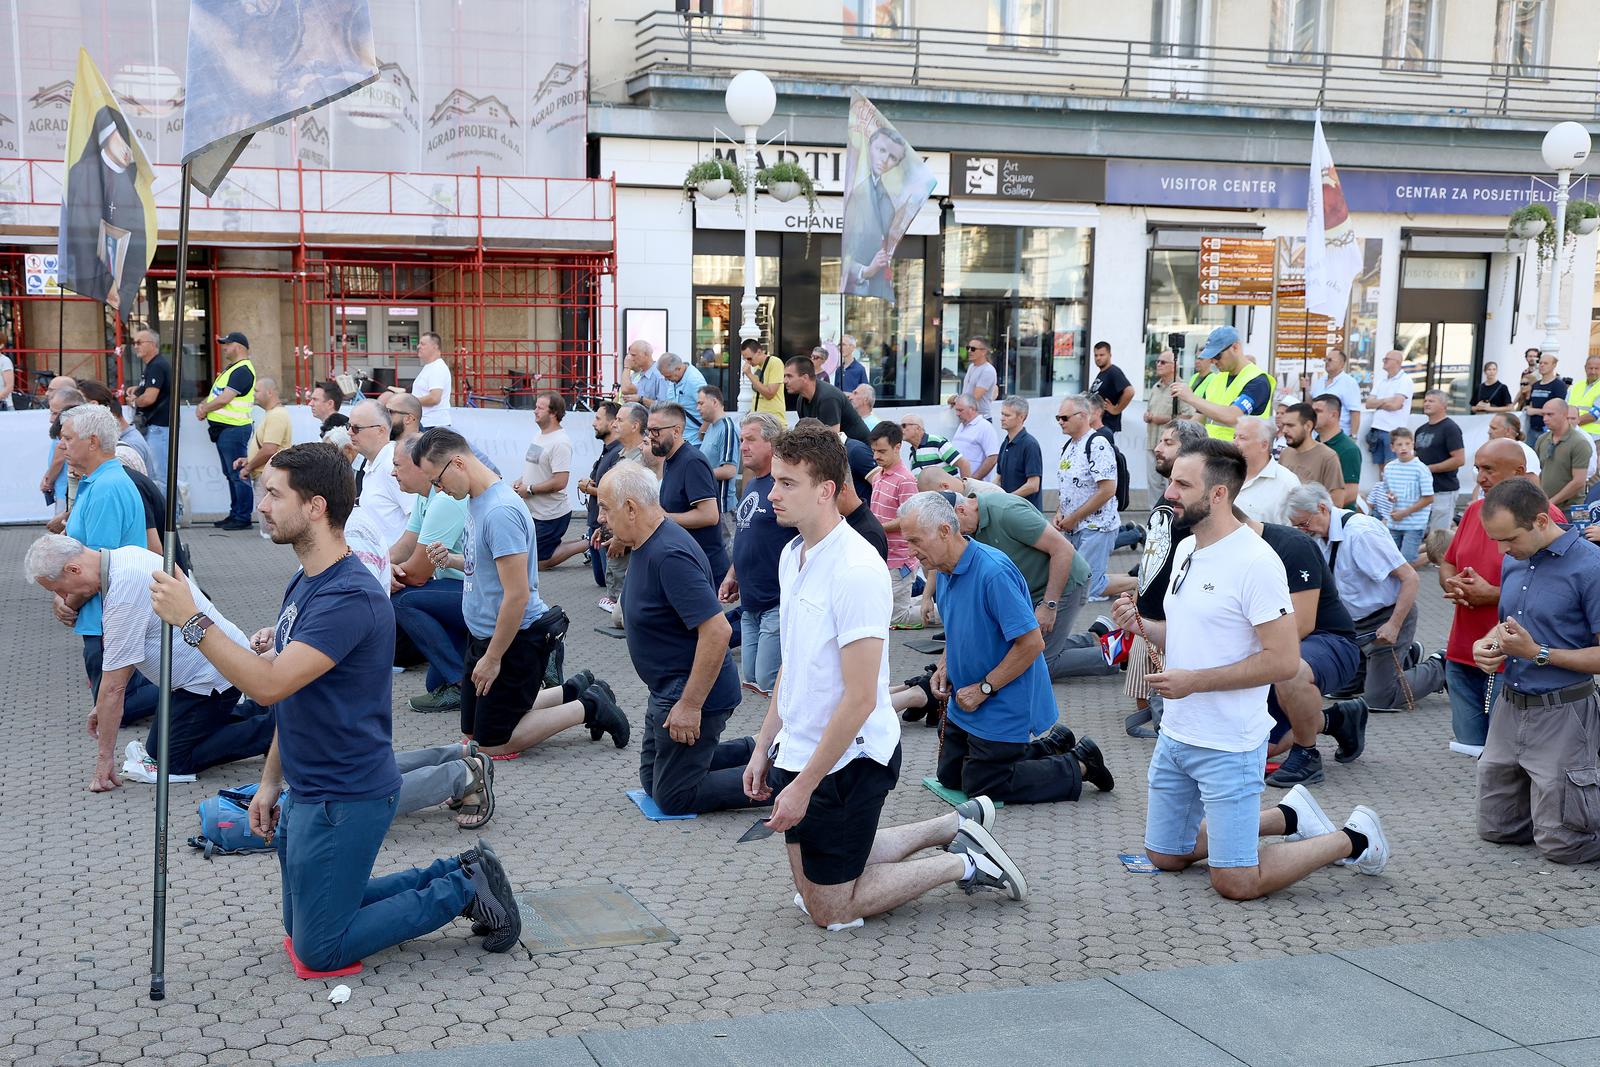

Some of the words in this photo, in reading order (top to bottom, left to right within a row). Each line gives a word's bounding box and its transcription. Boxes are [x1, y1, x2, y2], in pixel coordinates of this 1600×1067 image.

[530, 102, 555, 129] AGRAD
[427, 127, 456, 153] AGRAD
[458, 124, 498, 140] PROJEKT
[1002, 159, 1019, 171] Art
[1002, 170, 1034, 185] Square
[1160, 176, 1217, 191] VISITOR
[1223, 179, 1277, 193] CENTER
[1002, 183, 1035, 198] Gallery
[1395, 185, 1447, 199] CENTAR
[1451, 188, 1468, 200] ZA
[1473, 188, 1559, 203] POSJETITELJE
[785, 215, 844, 229] CHANE
[1442, 270, 1476, 280] CENTER
